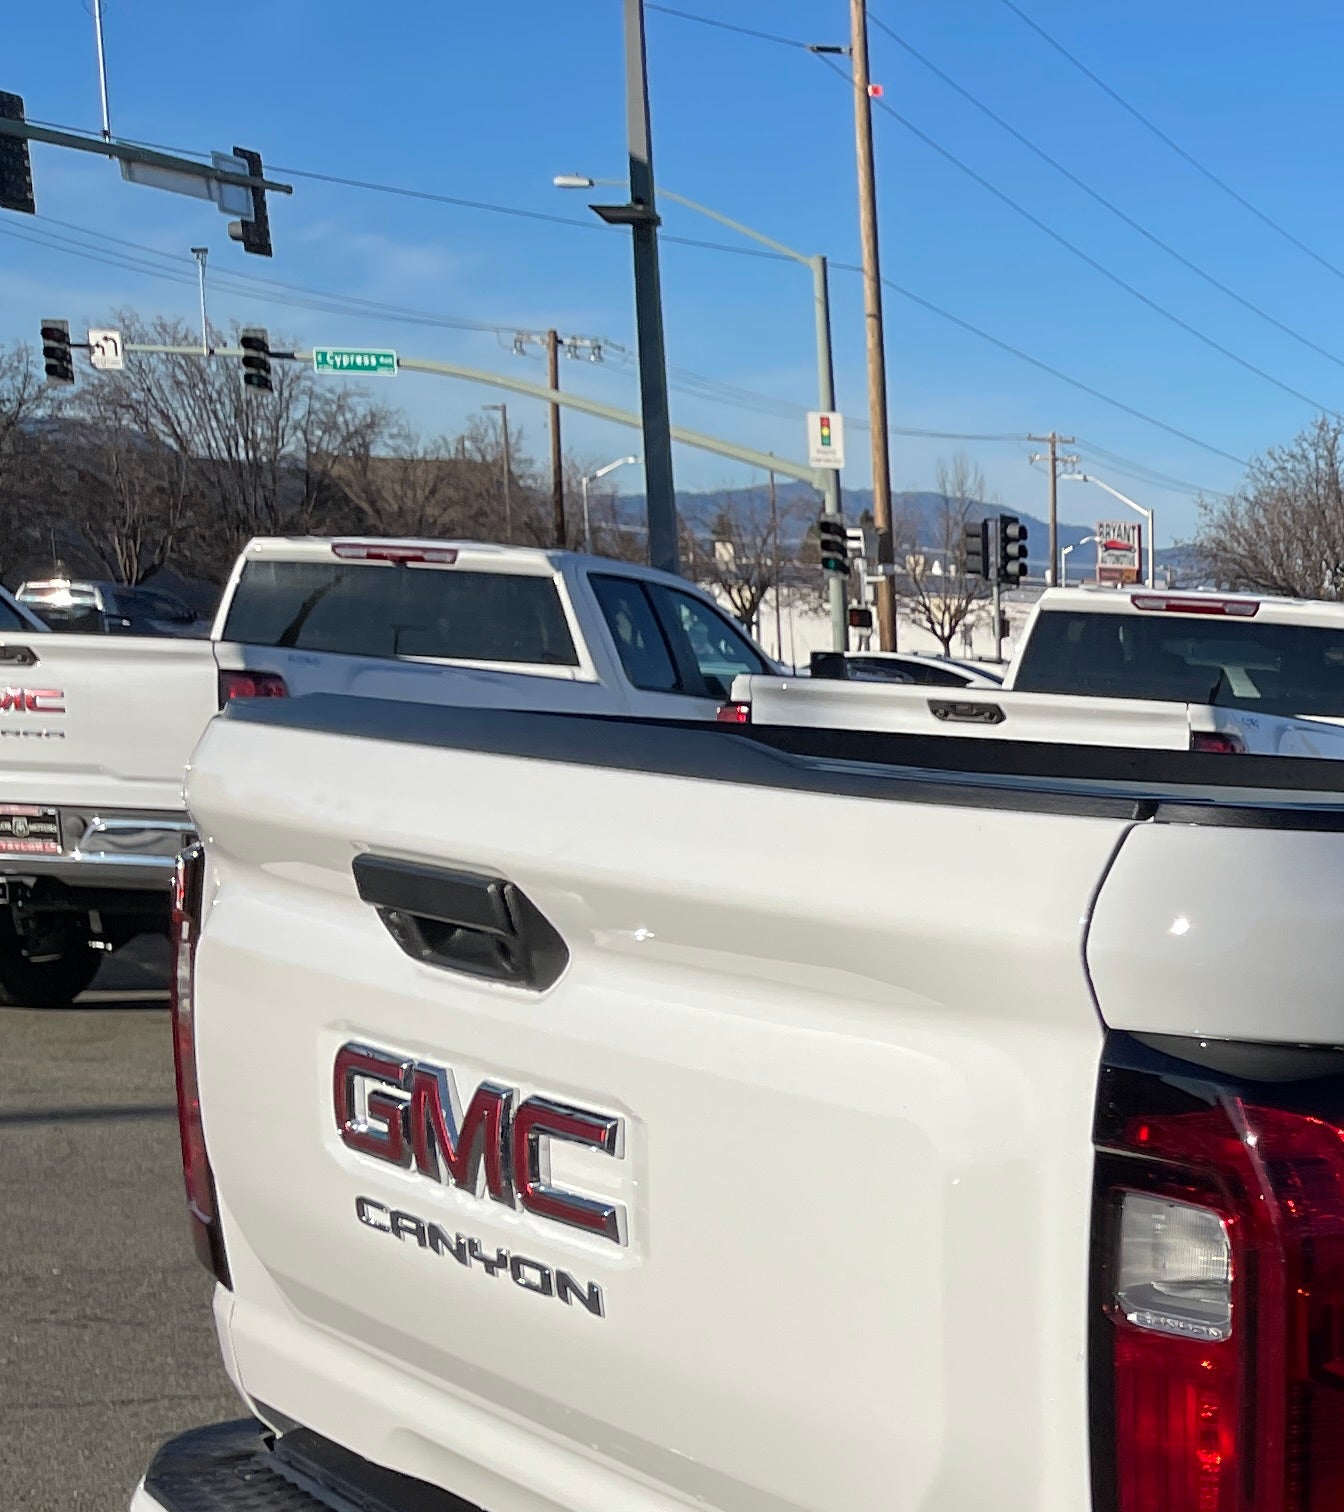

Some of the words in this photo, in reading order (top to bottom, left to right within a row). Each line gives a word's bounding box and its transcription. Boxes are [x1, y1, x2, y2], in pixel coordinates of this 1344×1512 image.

[326, 350, 377, 368] Cypress
[1099, 521, 1137, 543] BRYANT
[0, 688, 66, 713] MC
[332, 1040, 629, 1249] GMC
[354, 1195, 606, 1319] CANYON
